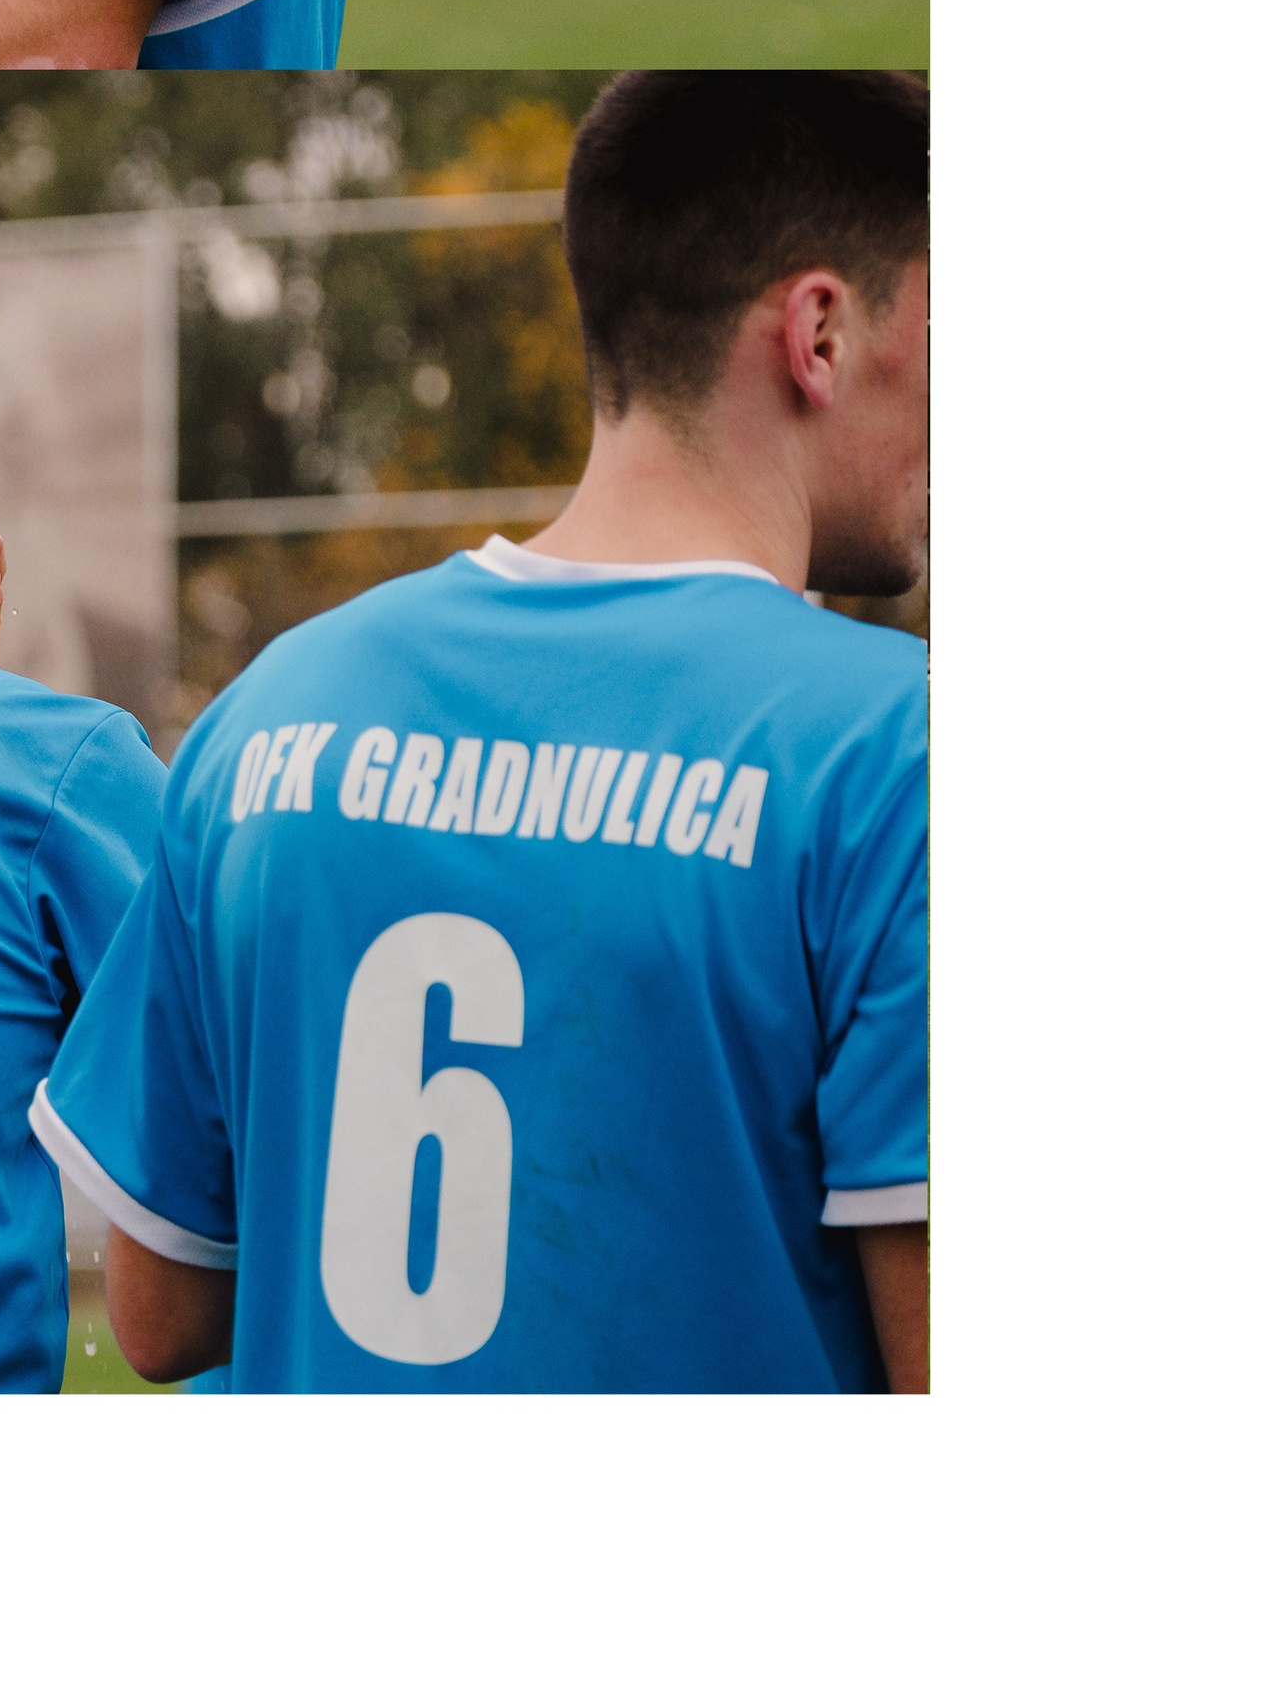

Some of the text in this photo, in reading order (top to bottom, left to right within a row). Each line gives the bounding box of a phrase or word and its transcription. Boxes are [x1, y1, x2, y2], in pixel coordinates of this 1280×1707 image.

[231, 722, 769, 869] OFK GRADNULICA
[320, 912, 524, 1365] 6
